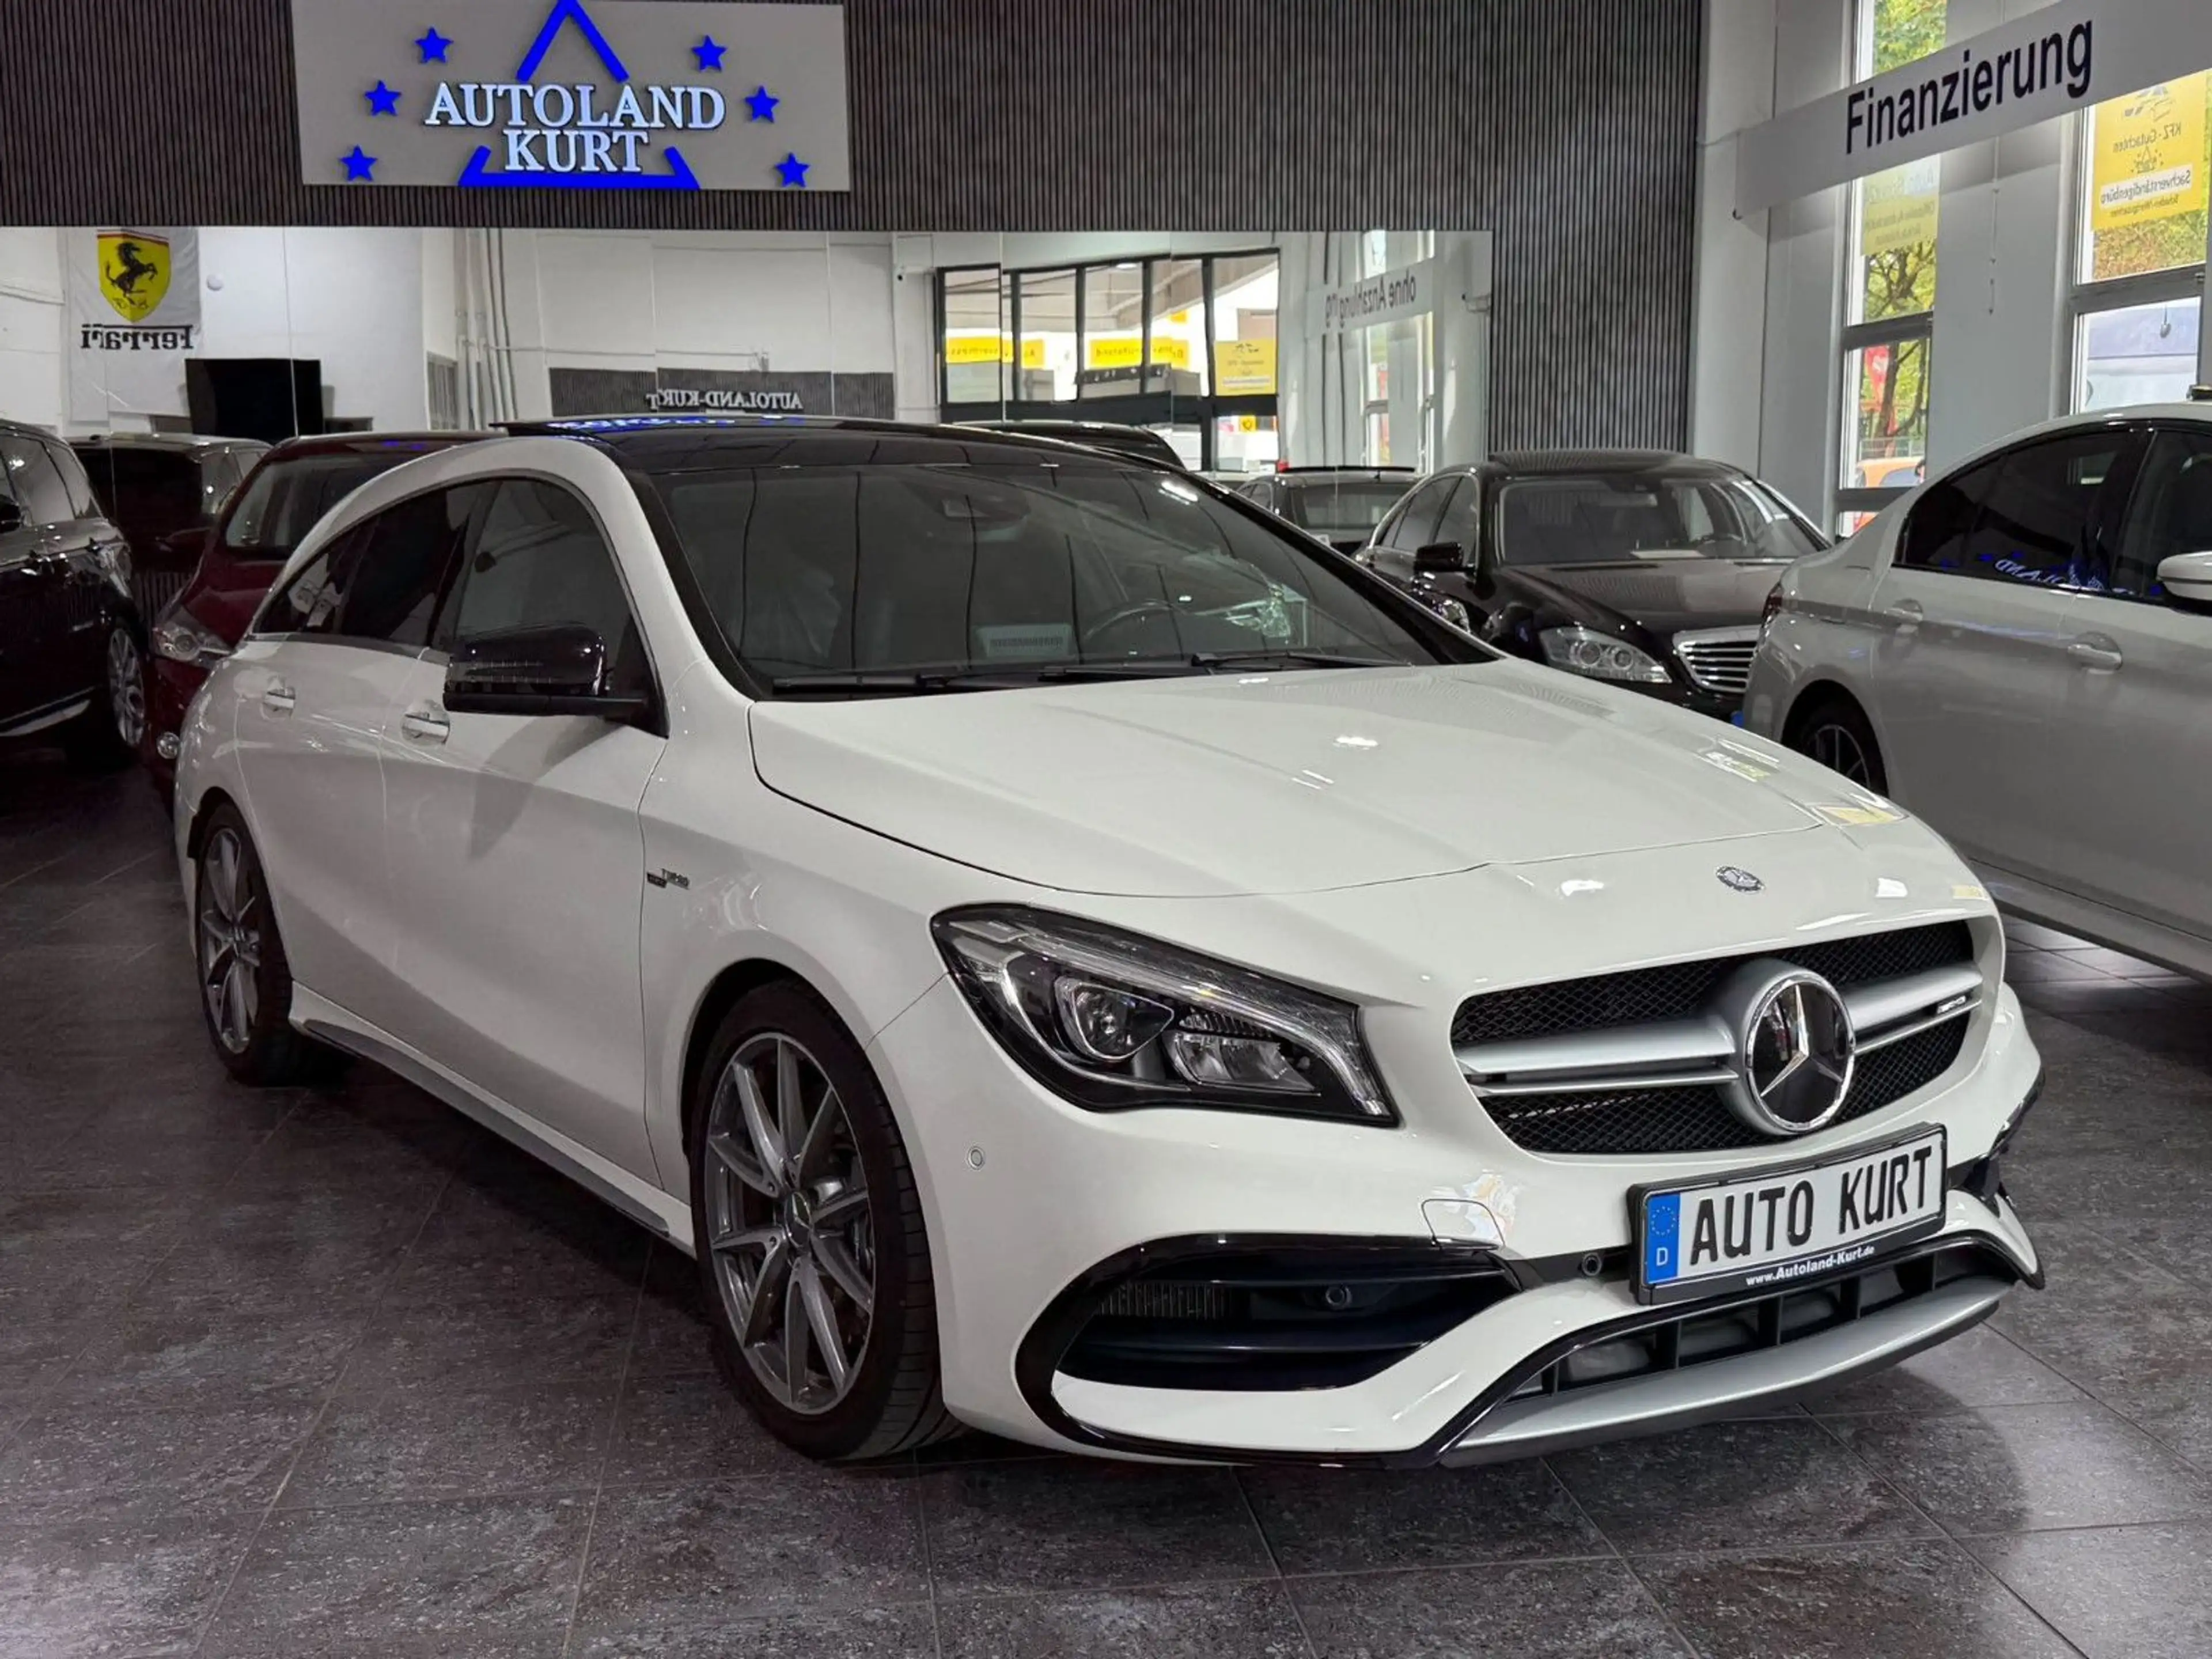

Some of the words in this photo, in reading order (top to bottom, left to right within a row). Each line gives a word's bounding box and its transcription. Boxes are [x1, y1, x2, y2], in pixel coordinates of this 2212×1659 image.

[425, 81, 726, 130] AUTOLAND
[1845, 20, 2093, 155] Finanzierung
[503, 128, 650, 173] KURT
[1690, 1179, 1815, 1266] AUTO
[1839, 1146, 1932, 1234] KURT
[1656, 1247, 1668, 1266] D
[1745, 1245, 1876, 1286] www.Autoland-Kurt.de
